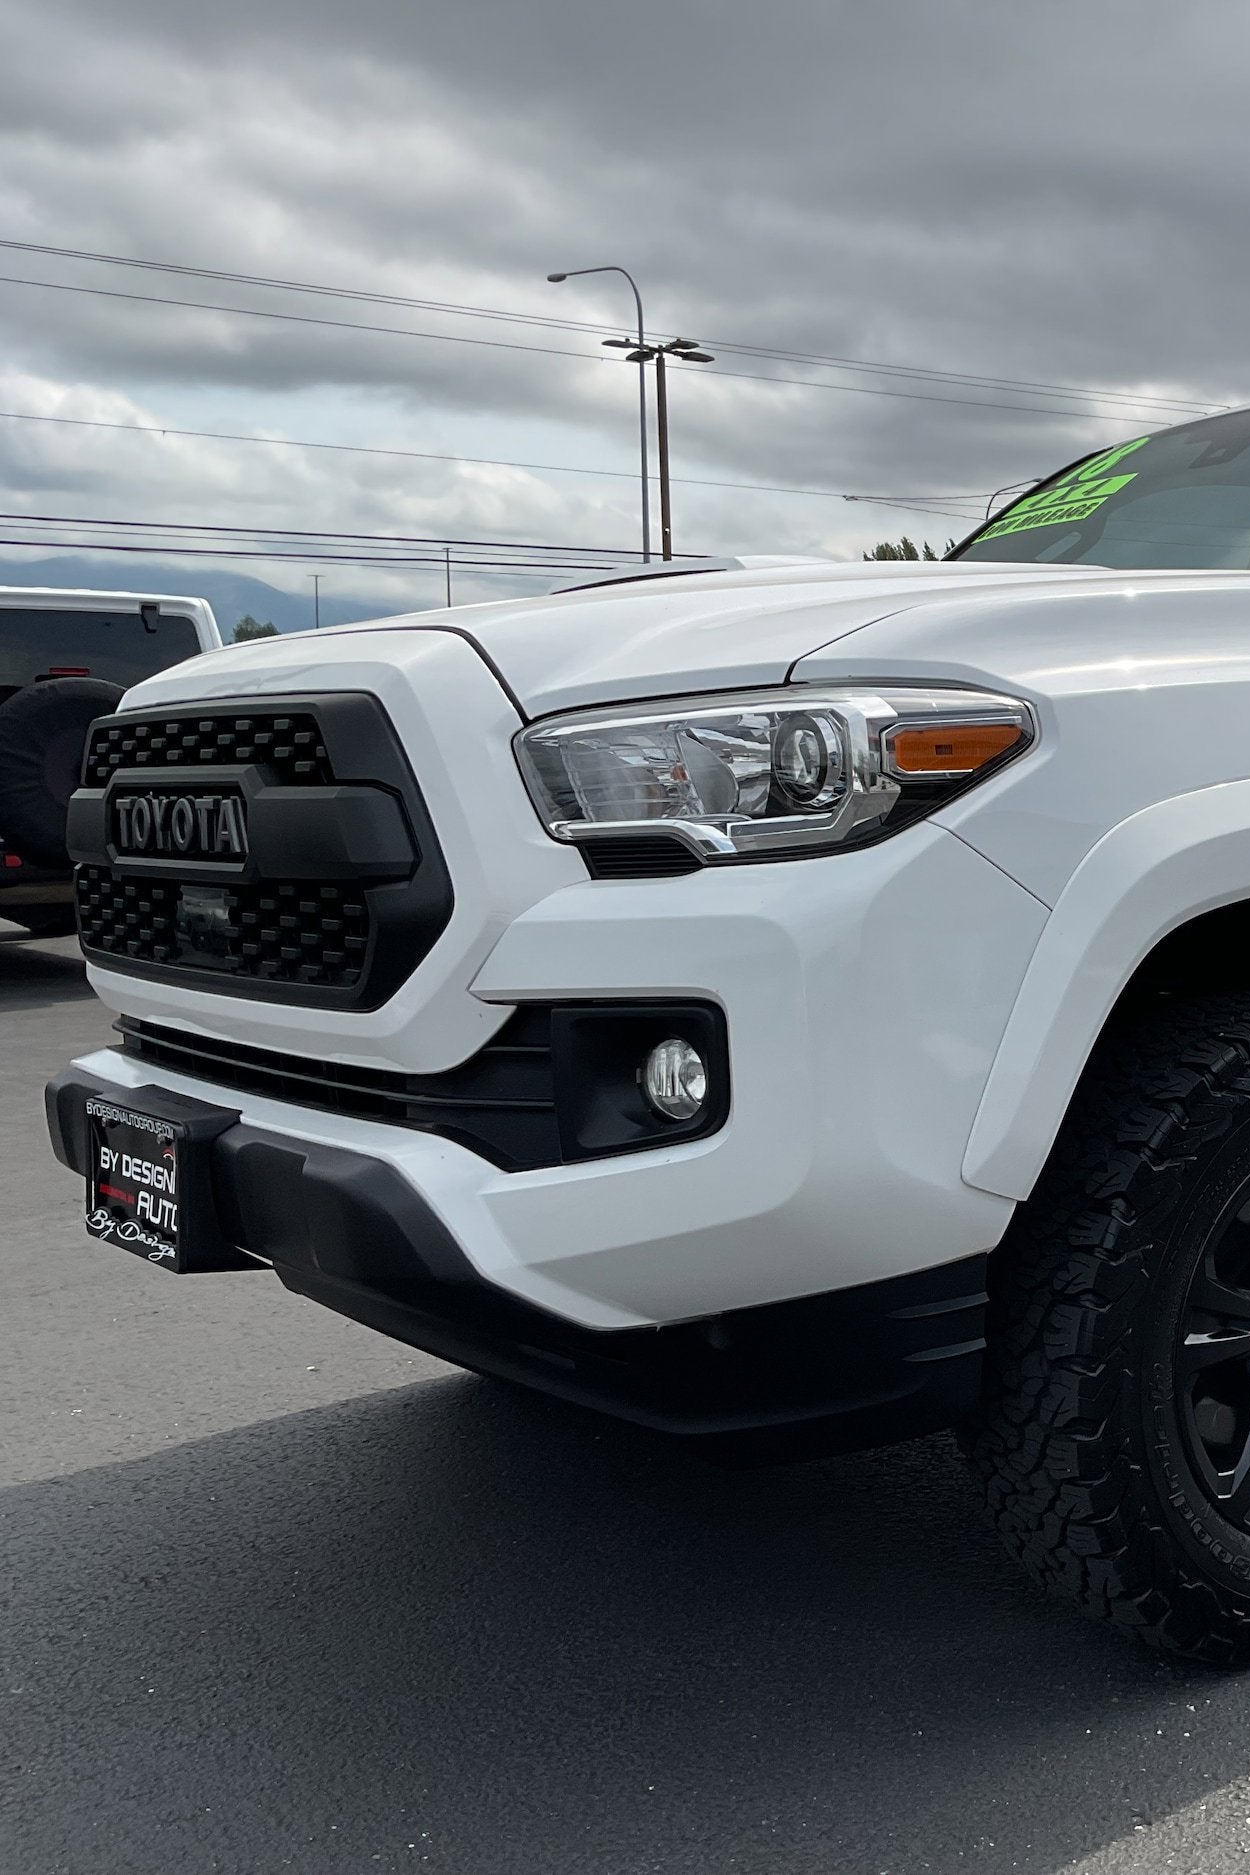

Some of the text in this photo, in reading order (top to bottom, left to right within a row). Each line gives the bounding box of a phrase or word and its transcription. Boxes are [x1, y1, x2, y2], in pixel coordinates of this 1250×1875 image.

[1013, 502, 1100, 530] MILEAGE
[115, 795, 249, 855] TOYOTA
[100, 1146, 176, 1195] BY DESIGN
[86, 1208, 117, 1240] By
